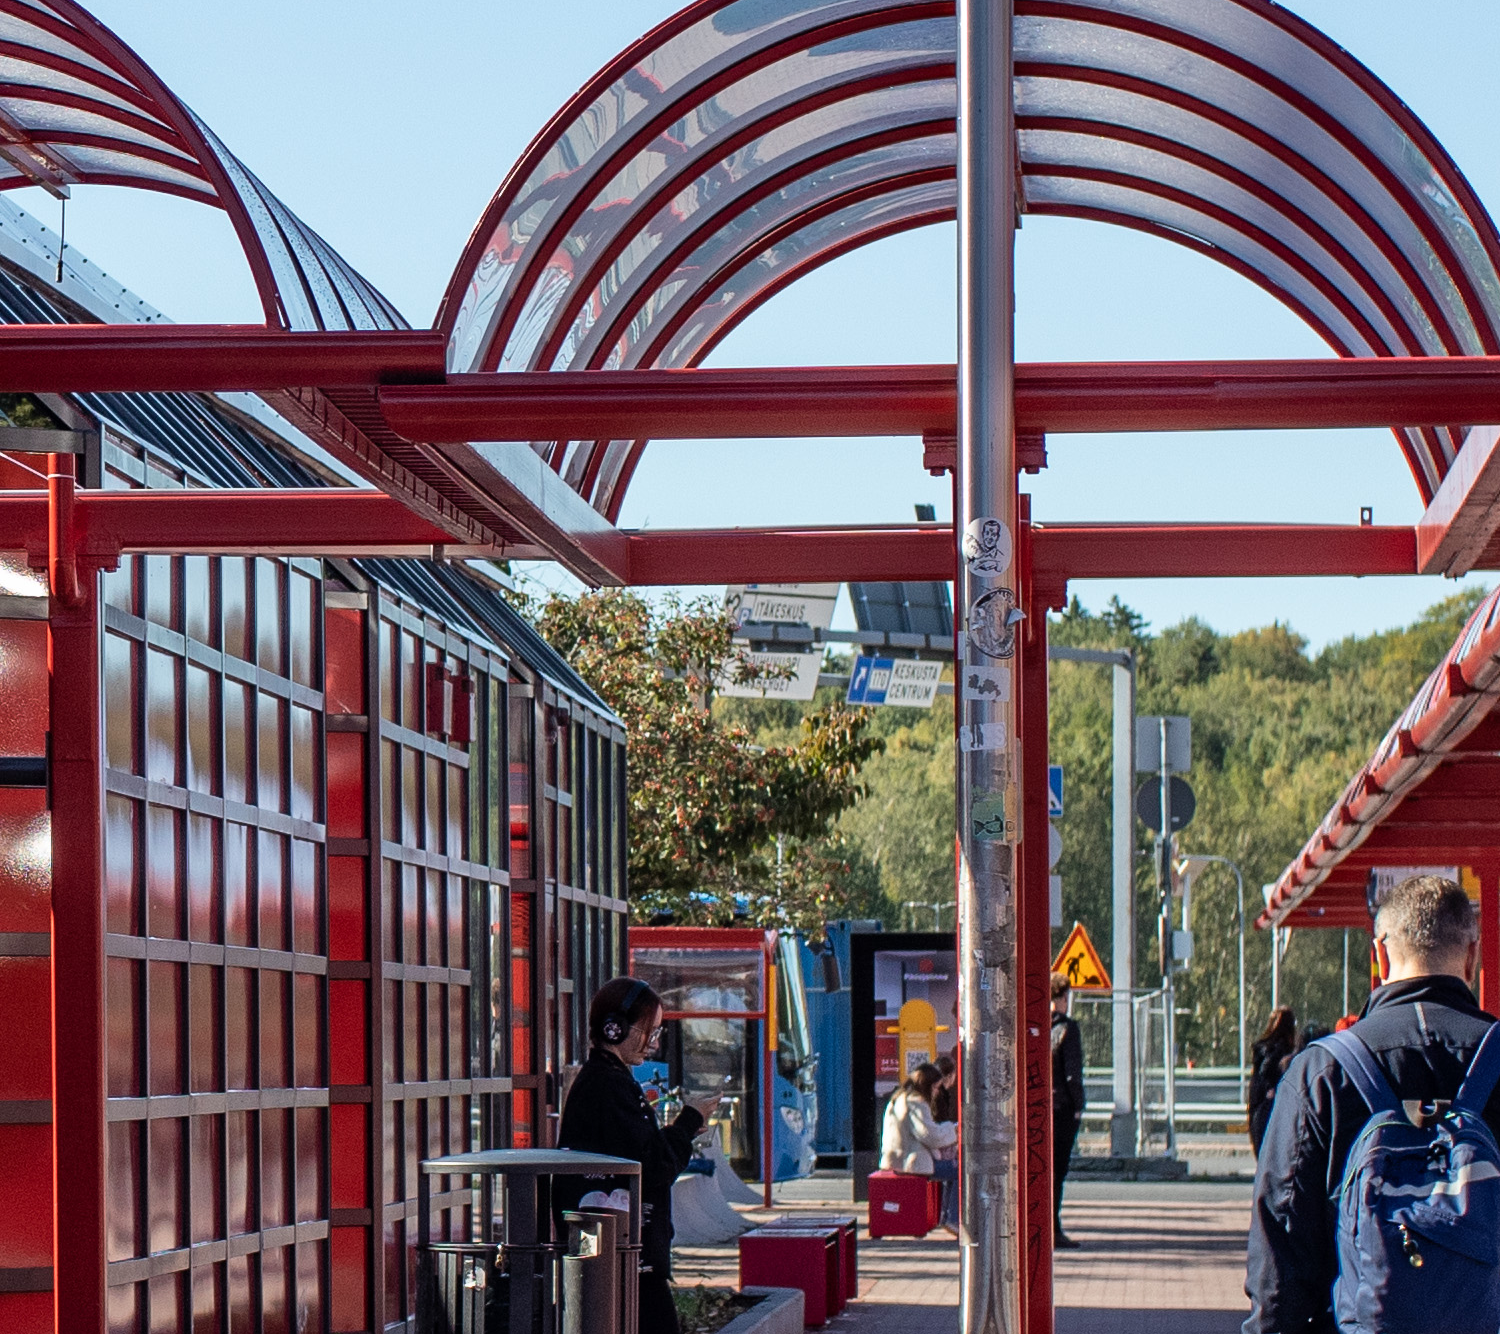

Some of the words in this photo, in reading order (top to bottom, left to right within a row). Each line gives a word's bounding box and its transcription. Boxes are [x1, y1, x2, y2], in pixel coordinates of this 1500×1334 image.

[754, 599, 806, 620] ITÄKESKUS
[894, 664, 938, 680] KESKUSTA
[889, 683, 932, 699] CENTRUM
